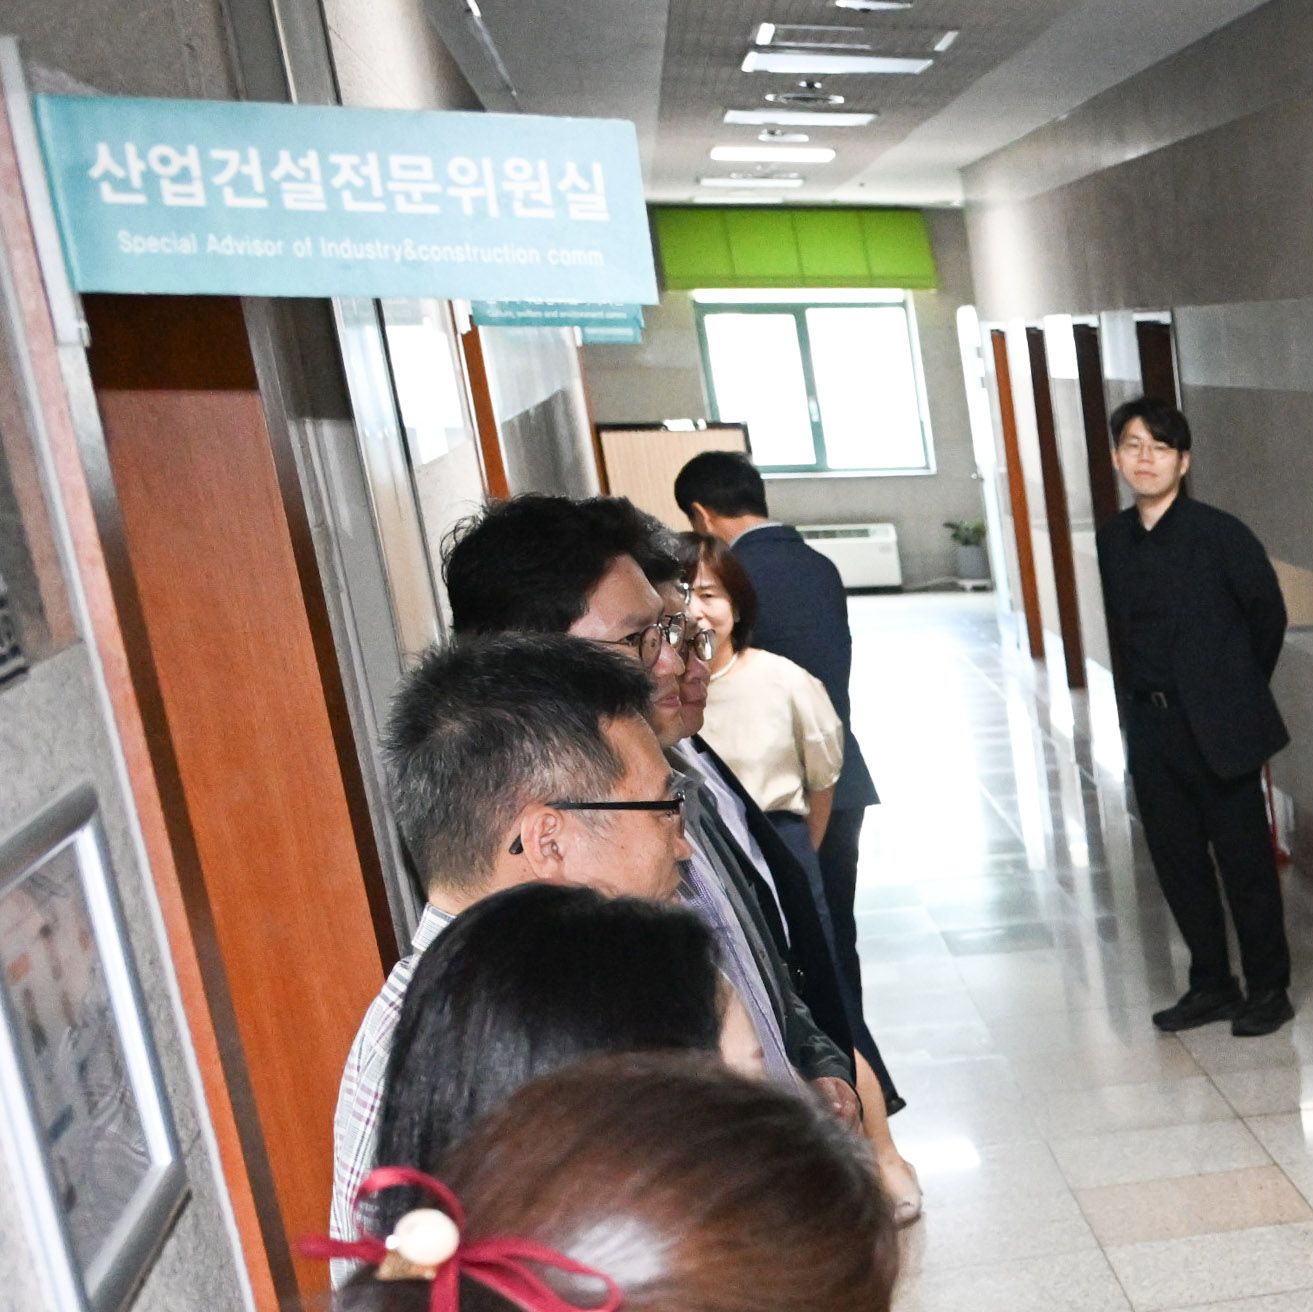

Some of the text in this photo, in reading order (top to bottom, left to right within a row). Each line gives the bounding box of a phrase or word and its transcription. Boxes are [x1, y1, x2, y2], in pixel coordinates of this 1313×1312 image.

[89, 142, 610, 222] 산업건설전문위원실
[118, 229, 604, 266] Special Advisor of Industry&construction comm
